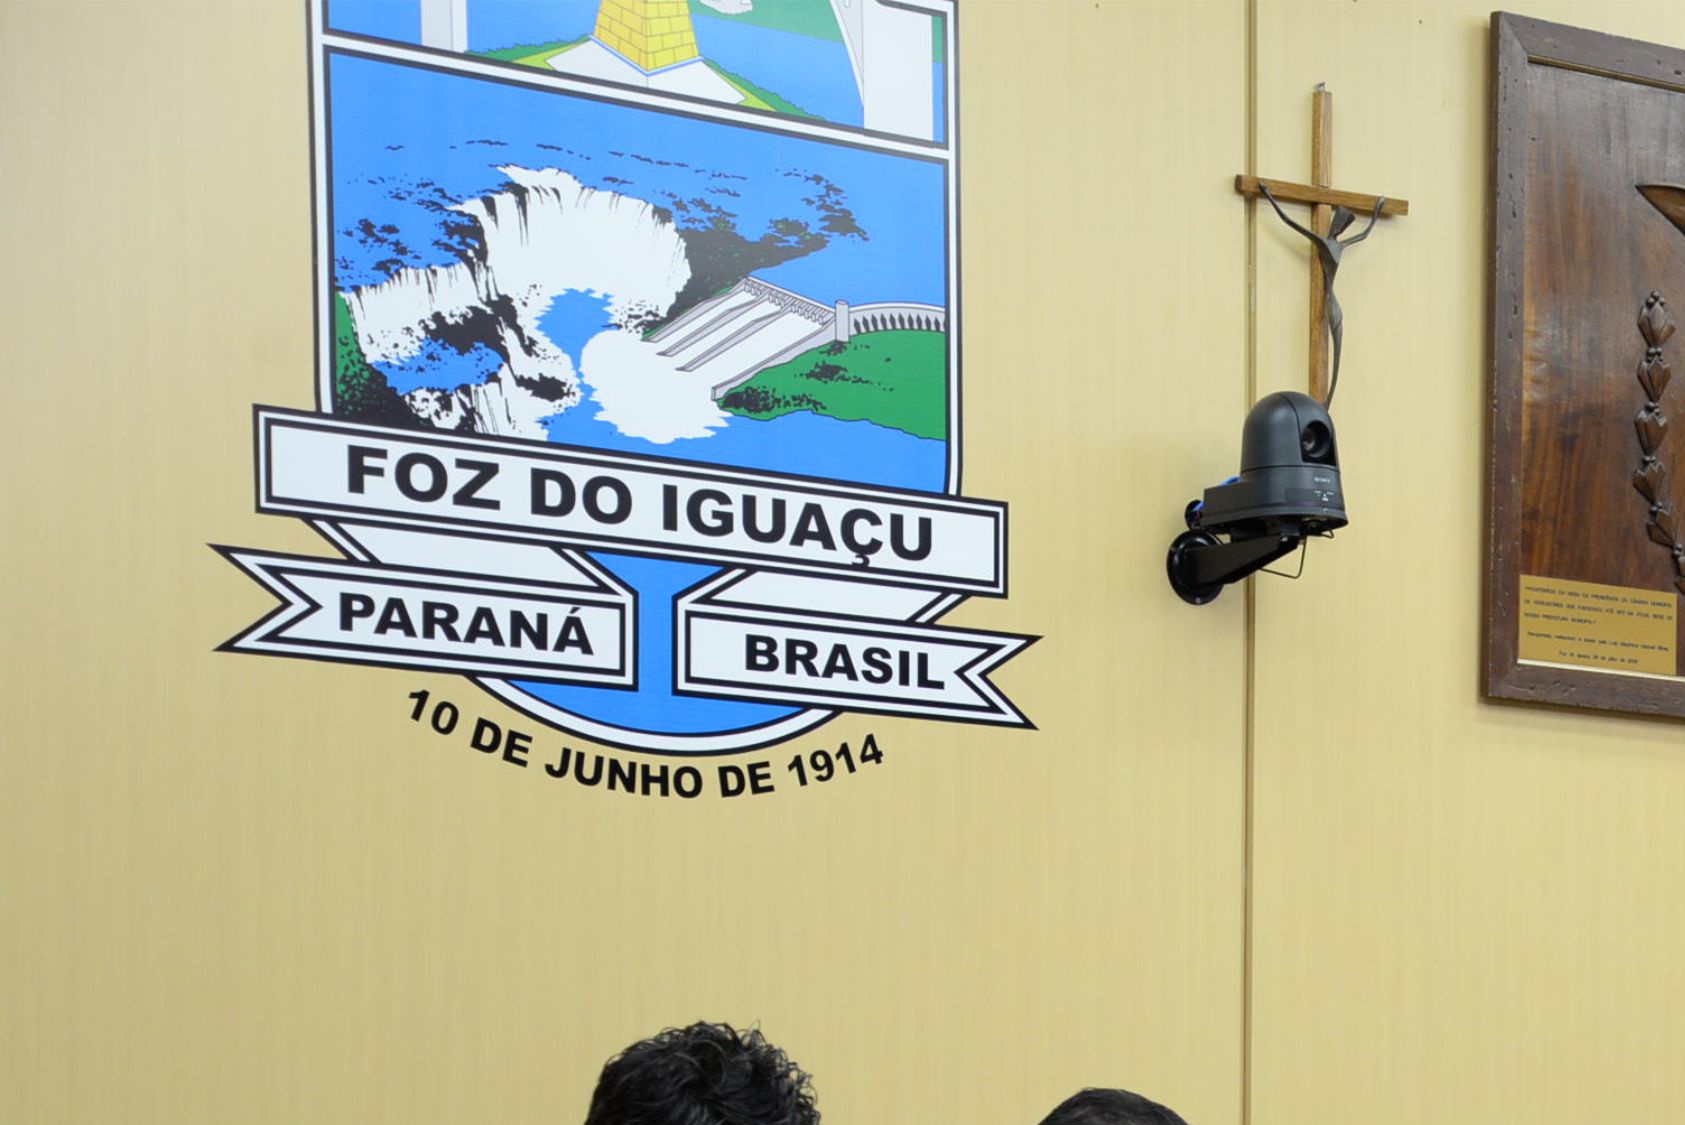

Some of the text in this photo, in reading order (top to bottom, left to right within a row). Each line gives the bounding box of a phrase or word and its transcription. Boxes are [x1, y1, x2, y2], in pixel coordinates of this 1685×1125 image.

[347, 445, 933, 567] FOZ DO IGUAÇU
[339, 591, 594, 655] PARANÁ
[745, 634, 946, 690] BRASIL
[408, 689, 884, 798] 10 DE JUNHO DE 1914
